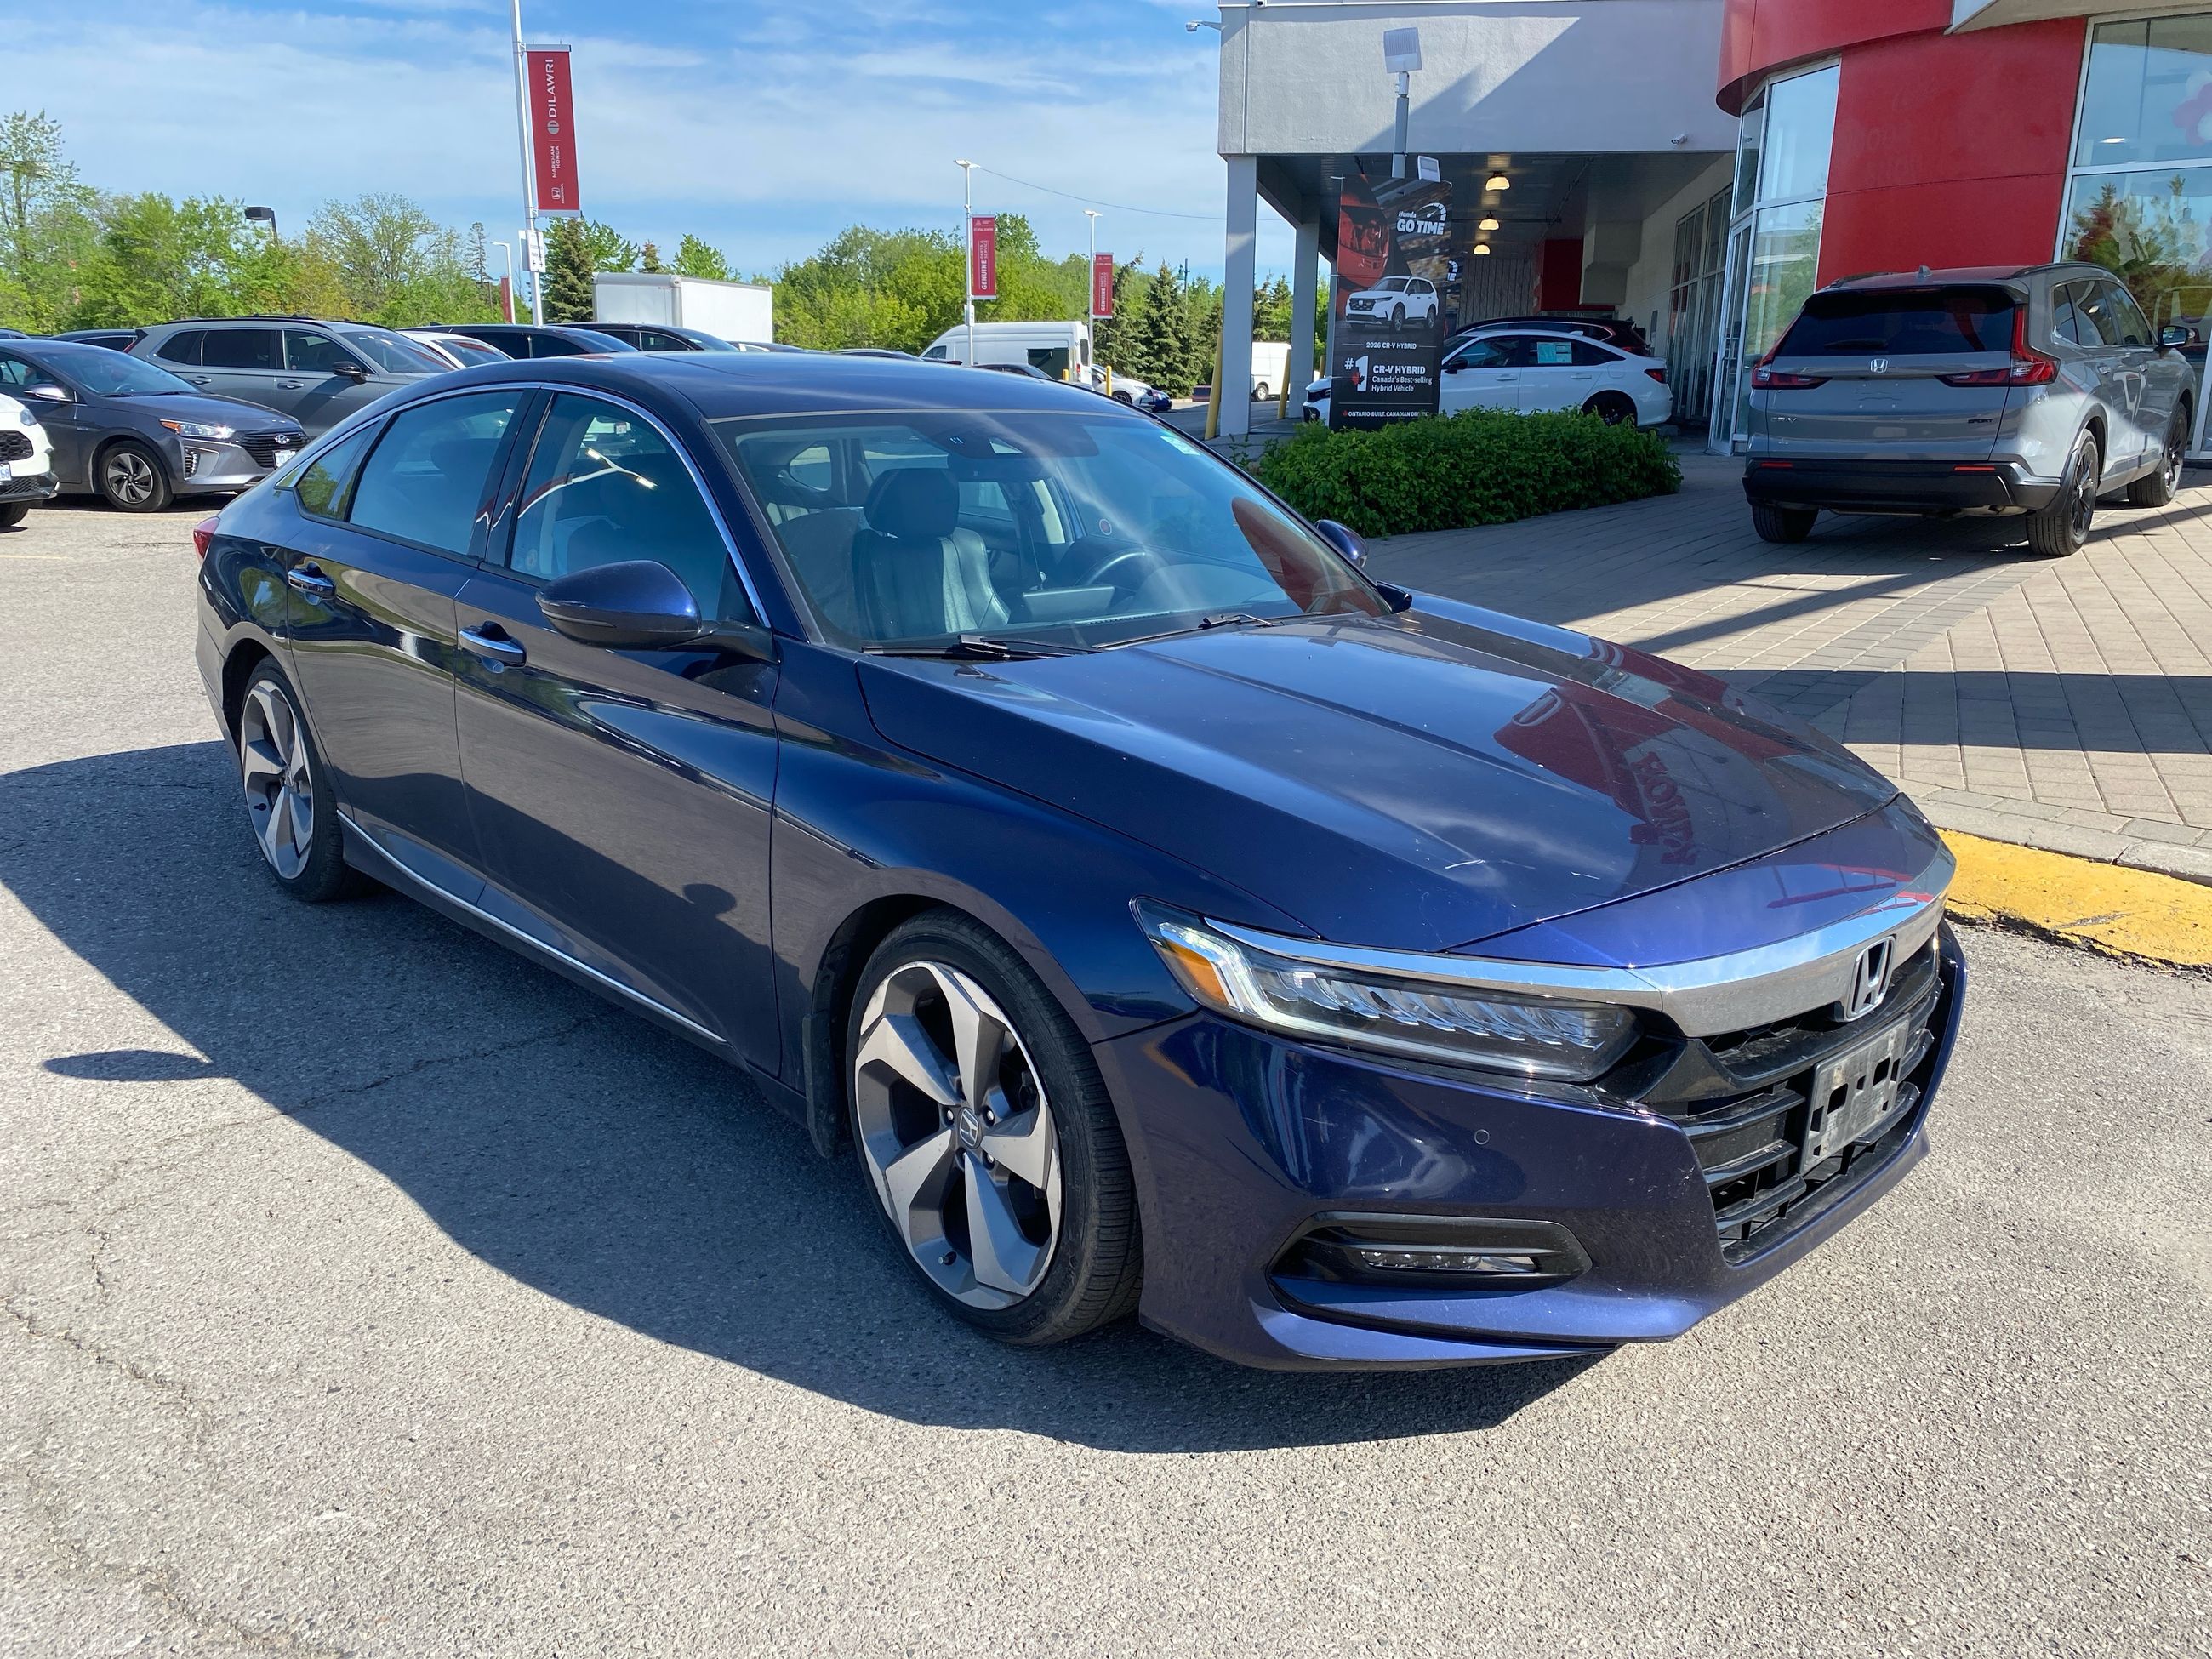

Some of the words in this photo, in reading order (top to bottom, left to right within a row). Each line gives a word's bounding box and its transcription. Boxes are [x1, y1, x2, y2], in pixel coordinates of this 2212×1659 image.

[545, 60, 557, 117] DILAWRI
[1398, 210, 1417, 219] Honda
[1397, 219, 1415, 232] GO
[1417, 220, 1445, 235] TIME
[1372, 365, 1394, 374] CR-V
[1394, 366, 1426, 375] HYBRID
[1371, 375, 1400, 384] Canada's
[1400, 376, 1433, 385] Best-selling
[1371, 384, 1393, 393] Hybrid
